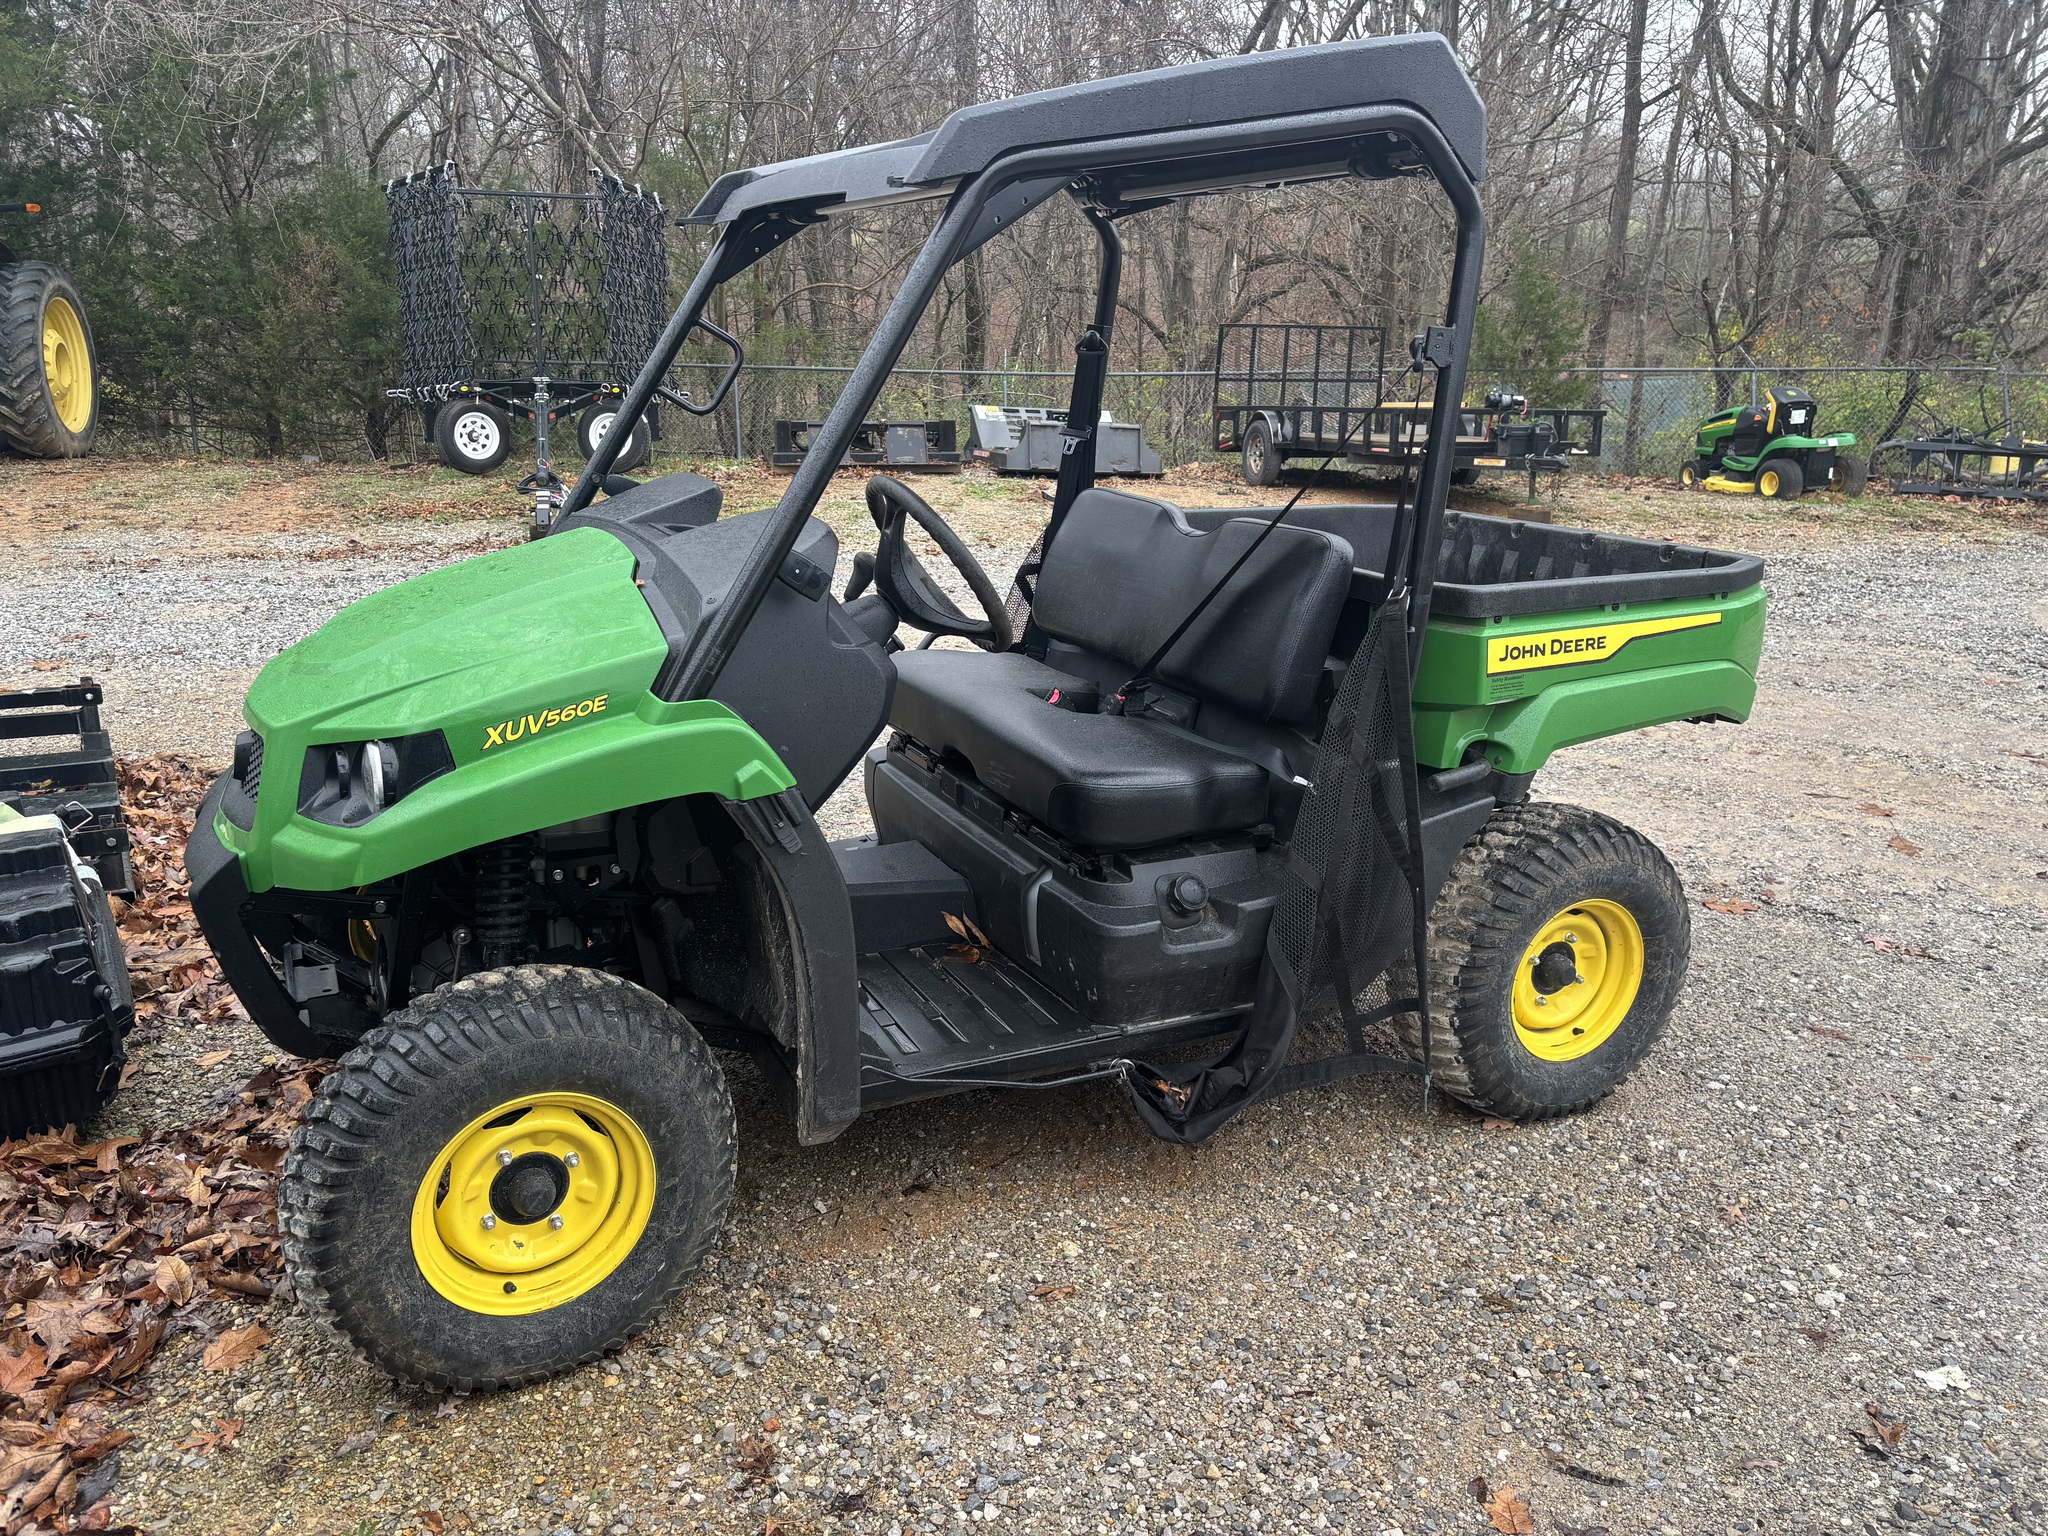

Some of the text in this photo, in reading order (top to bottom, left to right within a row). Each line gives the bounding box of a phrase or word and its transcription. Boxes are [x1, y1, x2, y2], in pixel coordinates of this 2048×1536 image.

[1499, 636, 1607, 661] JOHN DEERE
[480, 693, 609, 751] XUV560E
